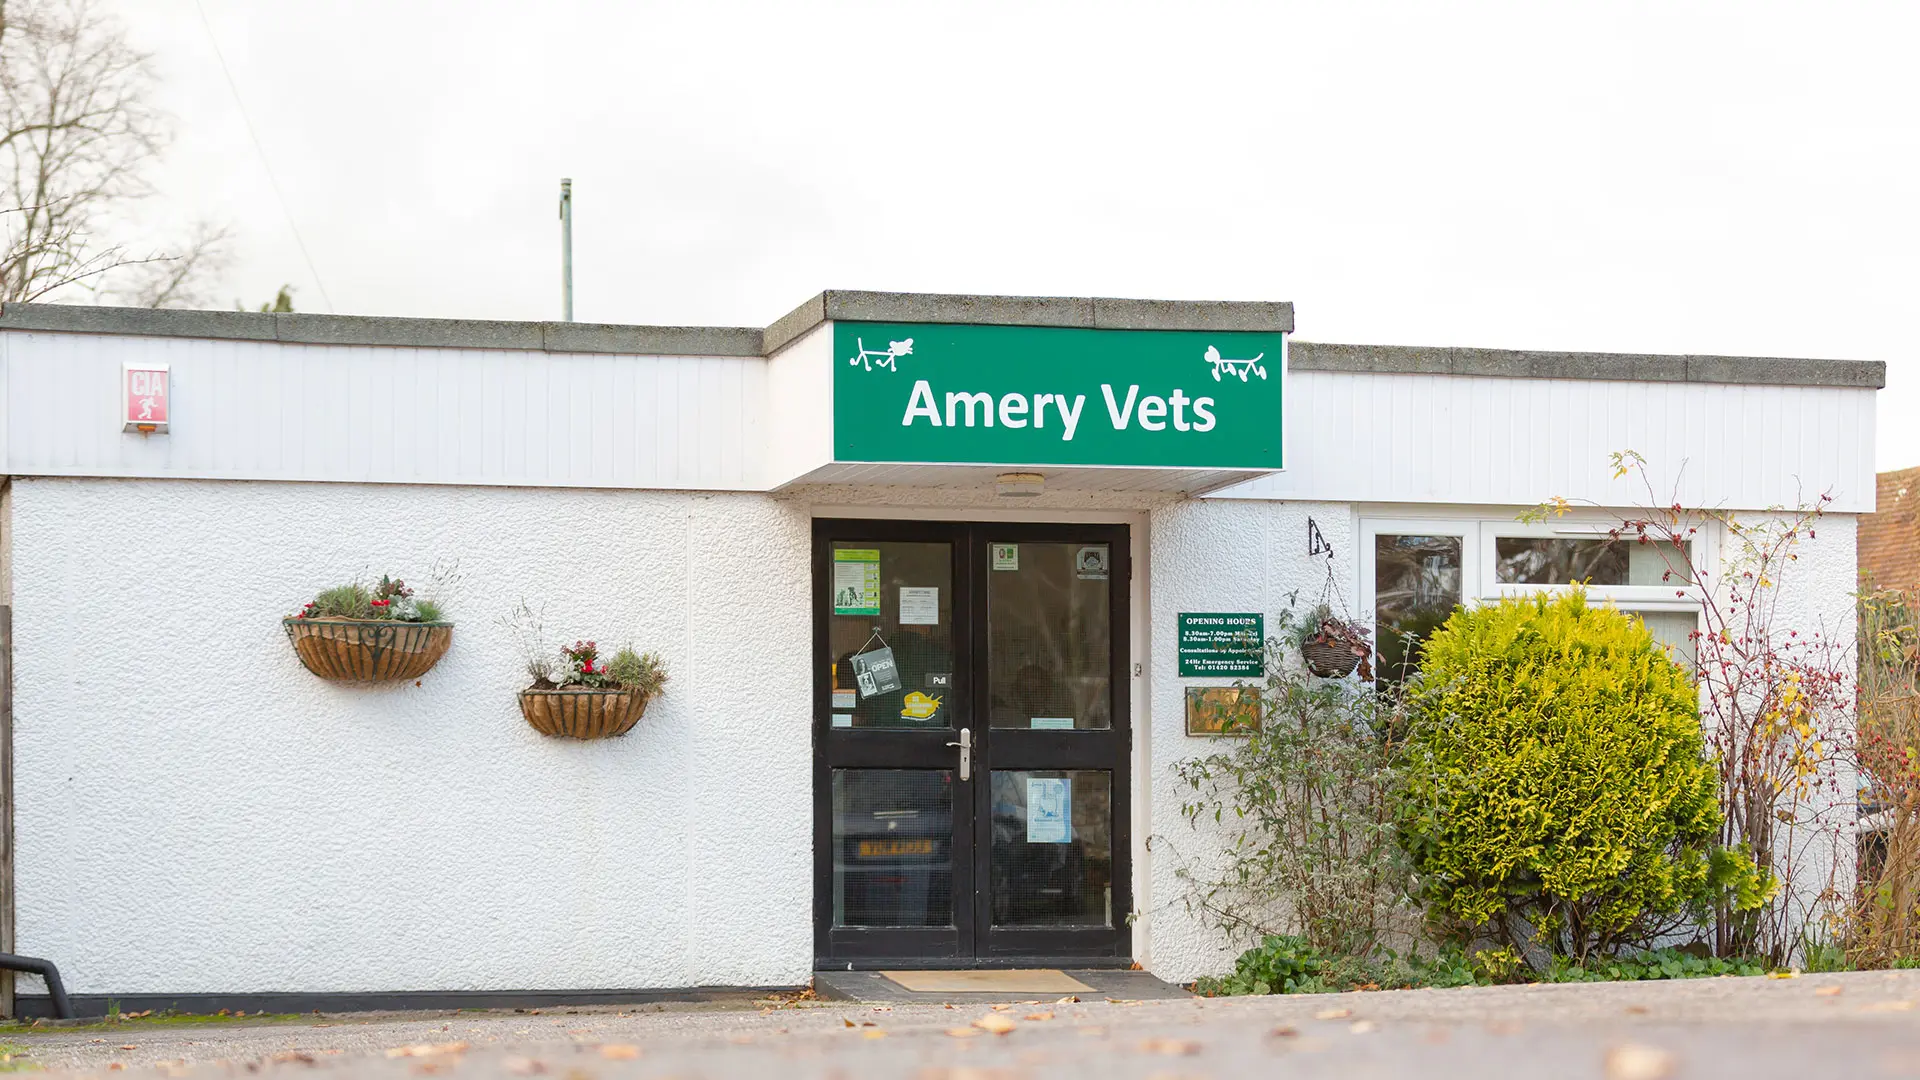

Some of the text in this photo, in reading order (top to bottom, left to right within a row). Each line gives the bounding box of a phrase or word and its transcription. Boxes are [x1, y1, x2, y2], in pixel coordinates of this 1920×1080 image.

[132, 371, 163, 396] CIA
[901, 379, 1217, 441] Amery Vets
[871, 659, 893, 672] OPEN
[933, 676, 947, 685] Pull
